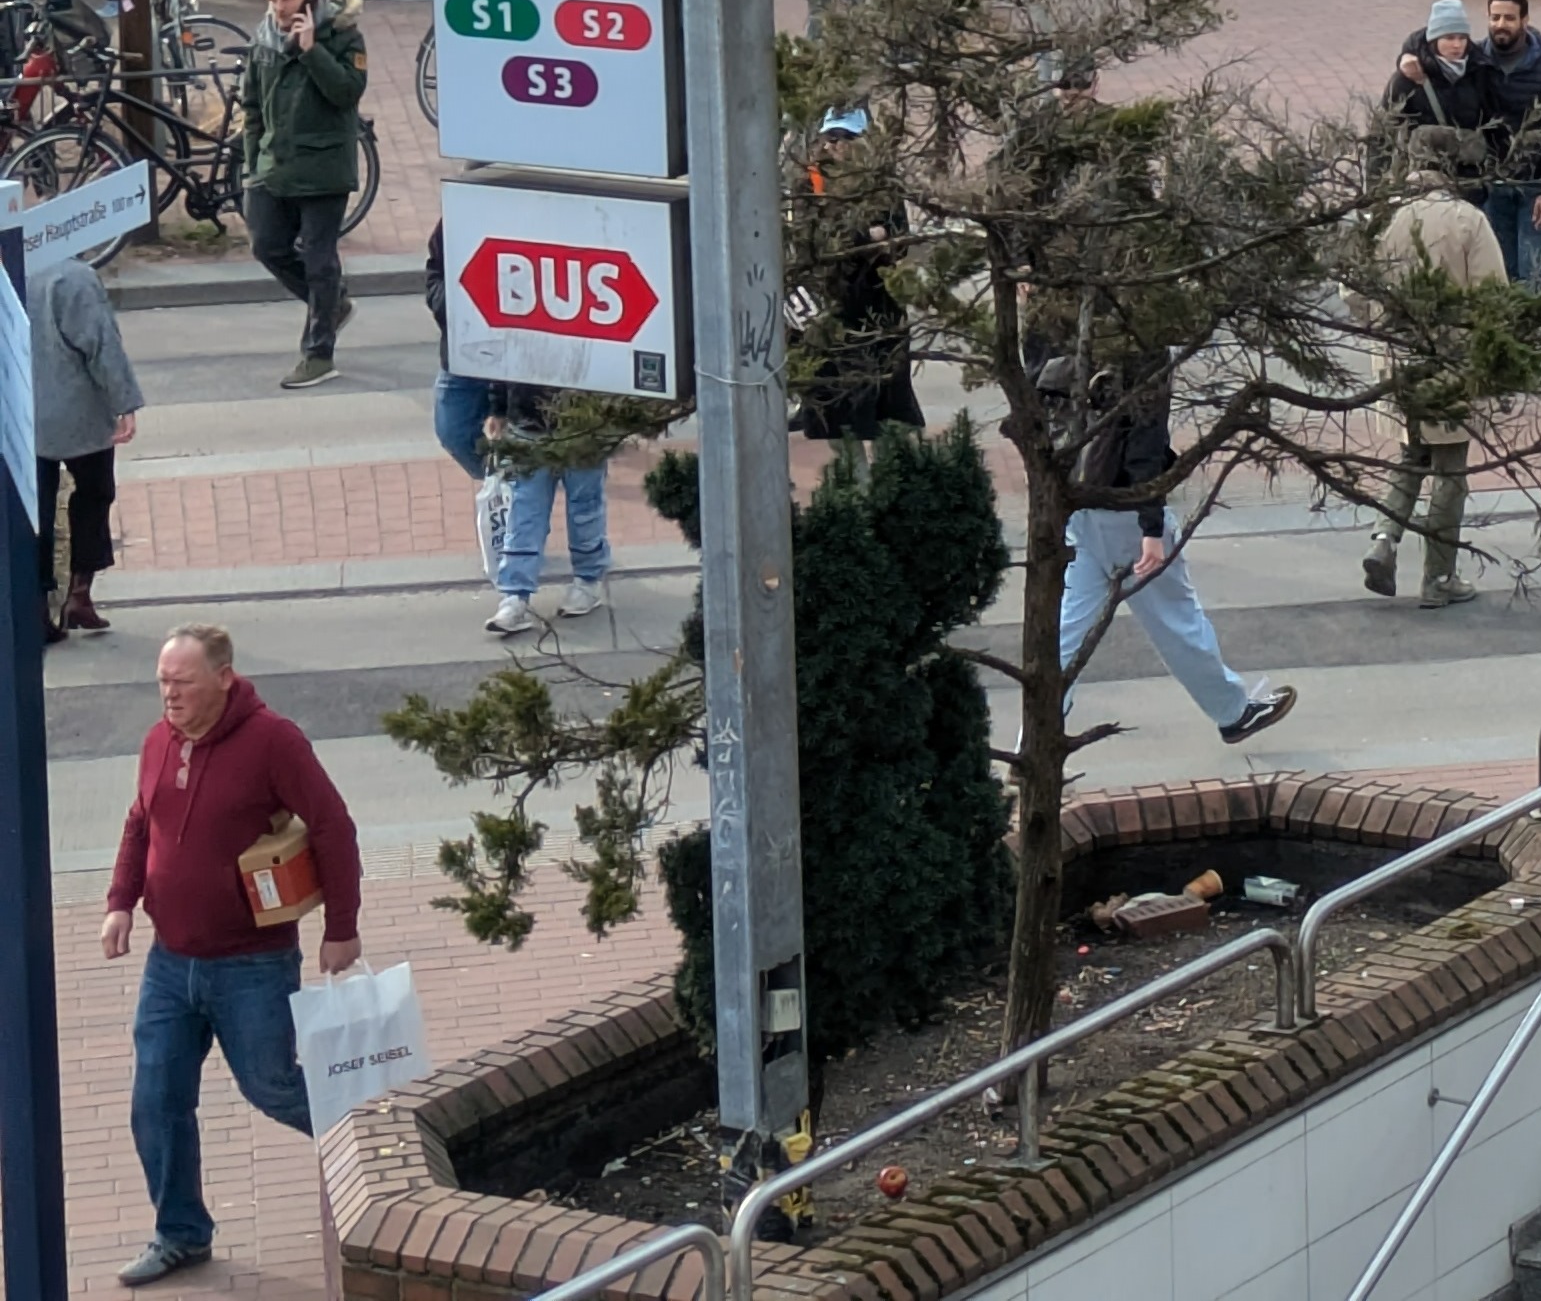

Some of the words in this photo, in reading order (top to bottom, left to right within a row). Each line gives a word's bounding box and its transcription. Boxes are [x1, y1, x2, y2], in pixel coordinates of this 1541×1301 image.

[583, 10, 625, 41] S2
[527, 65, 574, 99] S3
[496, 252, 624, 327] BUS
[328, 1056, 365, 1078] JOSEF
